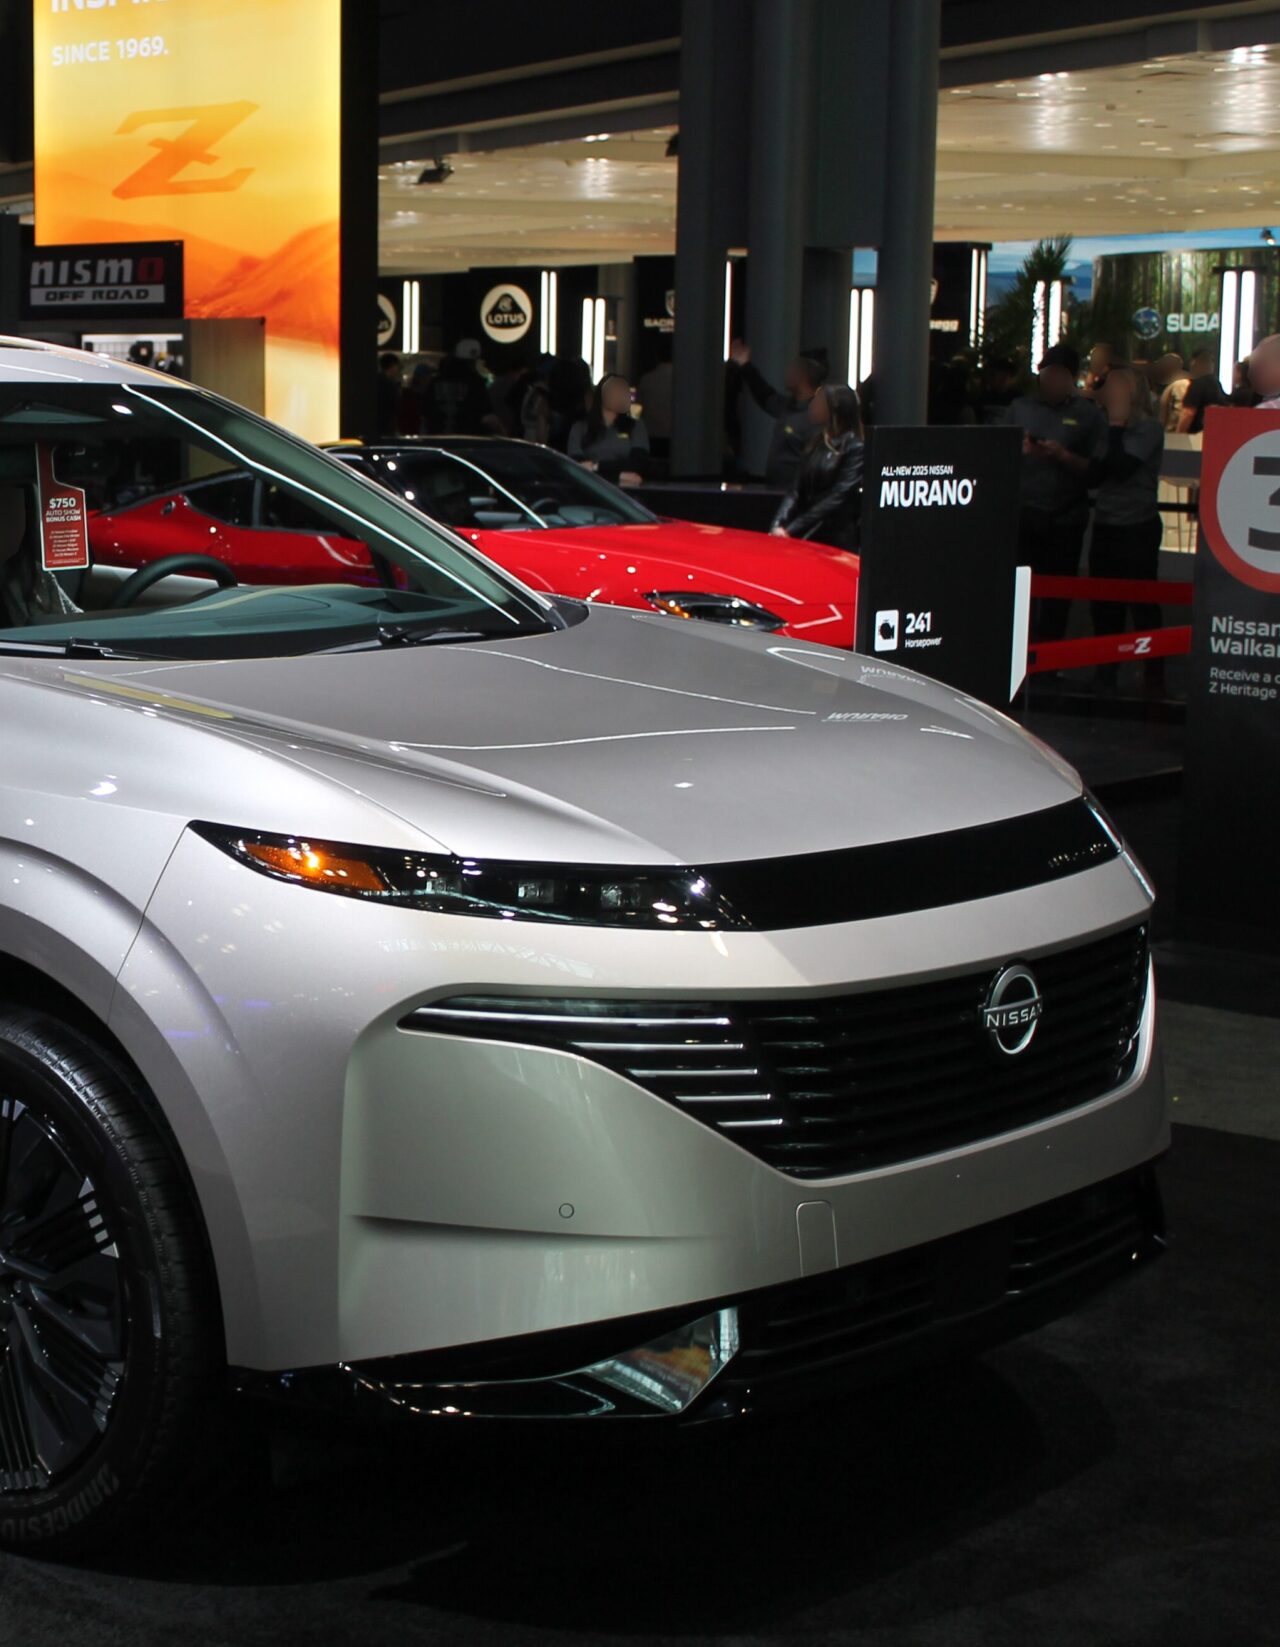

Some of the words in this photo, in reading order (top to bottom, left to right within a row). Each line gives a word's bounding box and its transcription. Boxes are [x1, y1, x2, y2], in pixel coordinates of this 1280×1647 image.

[52, 41, 110, 66] SINCE
[116, 36, 169, 59] 1969.
[112, 99, 260, 200] Z
[45, 291, 85, 301] OFF
[92, 289, 149, 300] ROAD
[487, 314, 525, 324] LOTUS
[1166, 313, 1220, 332] SUBA
[881, 466, 912, 476] ALL-NEW
[912, 465, 929, 476] 2025
[929, 465, 954, 475] NISSAN
[49, 497, 76, 509] $750
[905, 611, 931, 634] 241
[905, 637, 942, 648] Horsepower
[1134, 636, 1152, 655] Z
[1209, 666, 1260, 682] Receive
[1263, 673, 1272, 683] a
[1209, 681, 1218, 693] Z
[1220, 683, 1277, 700] Heritage
